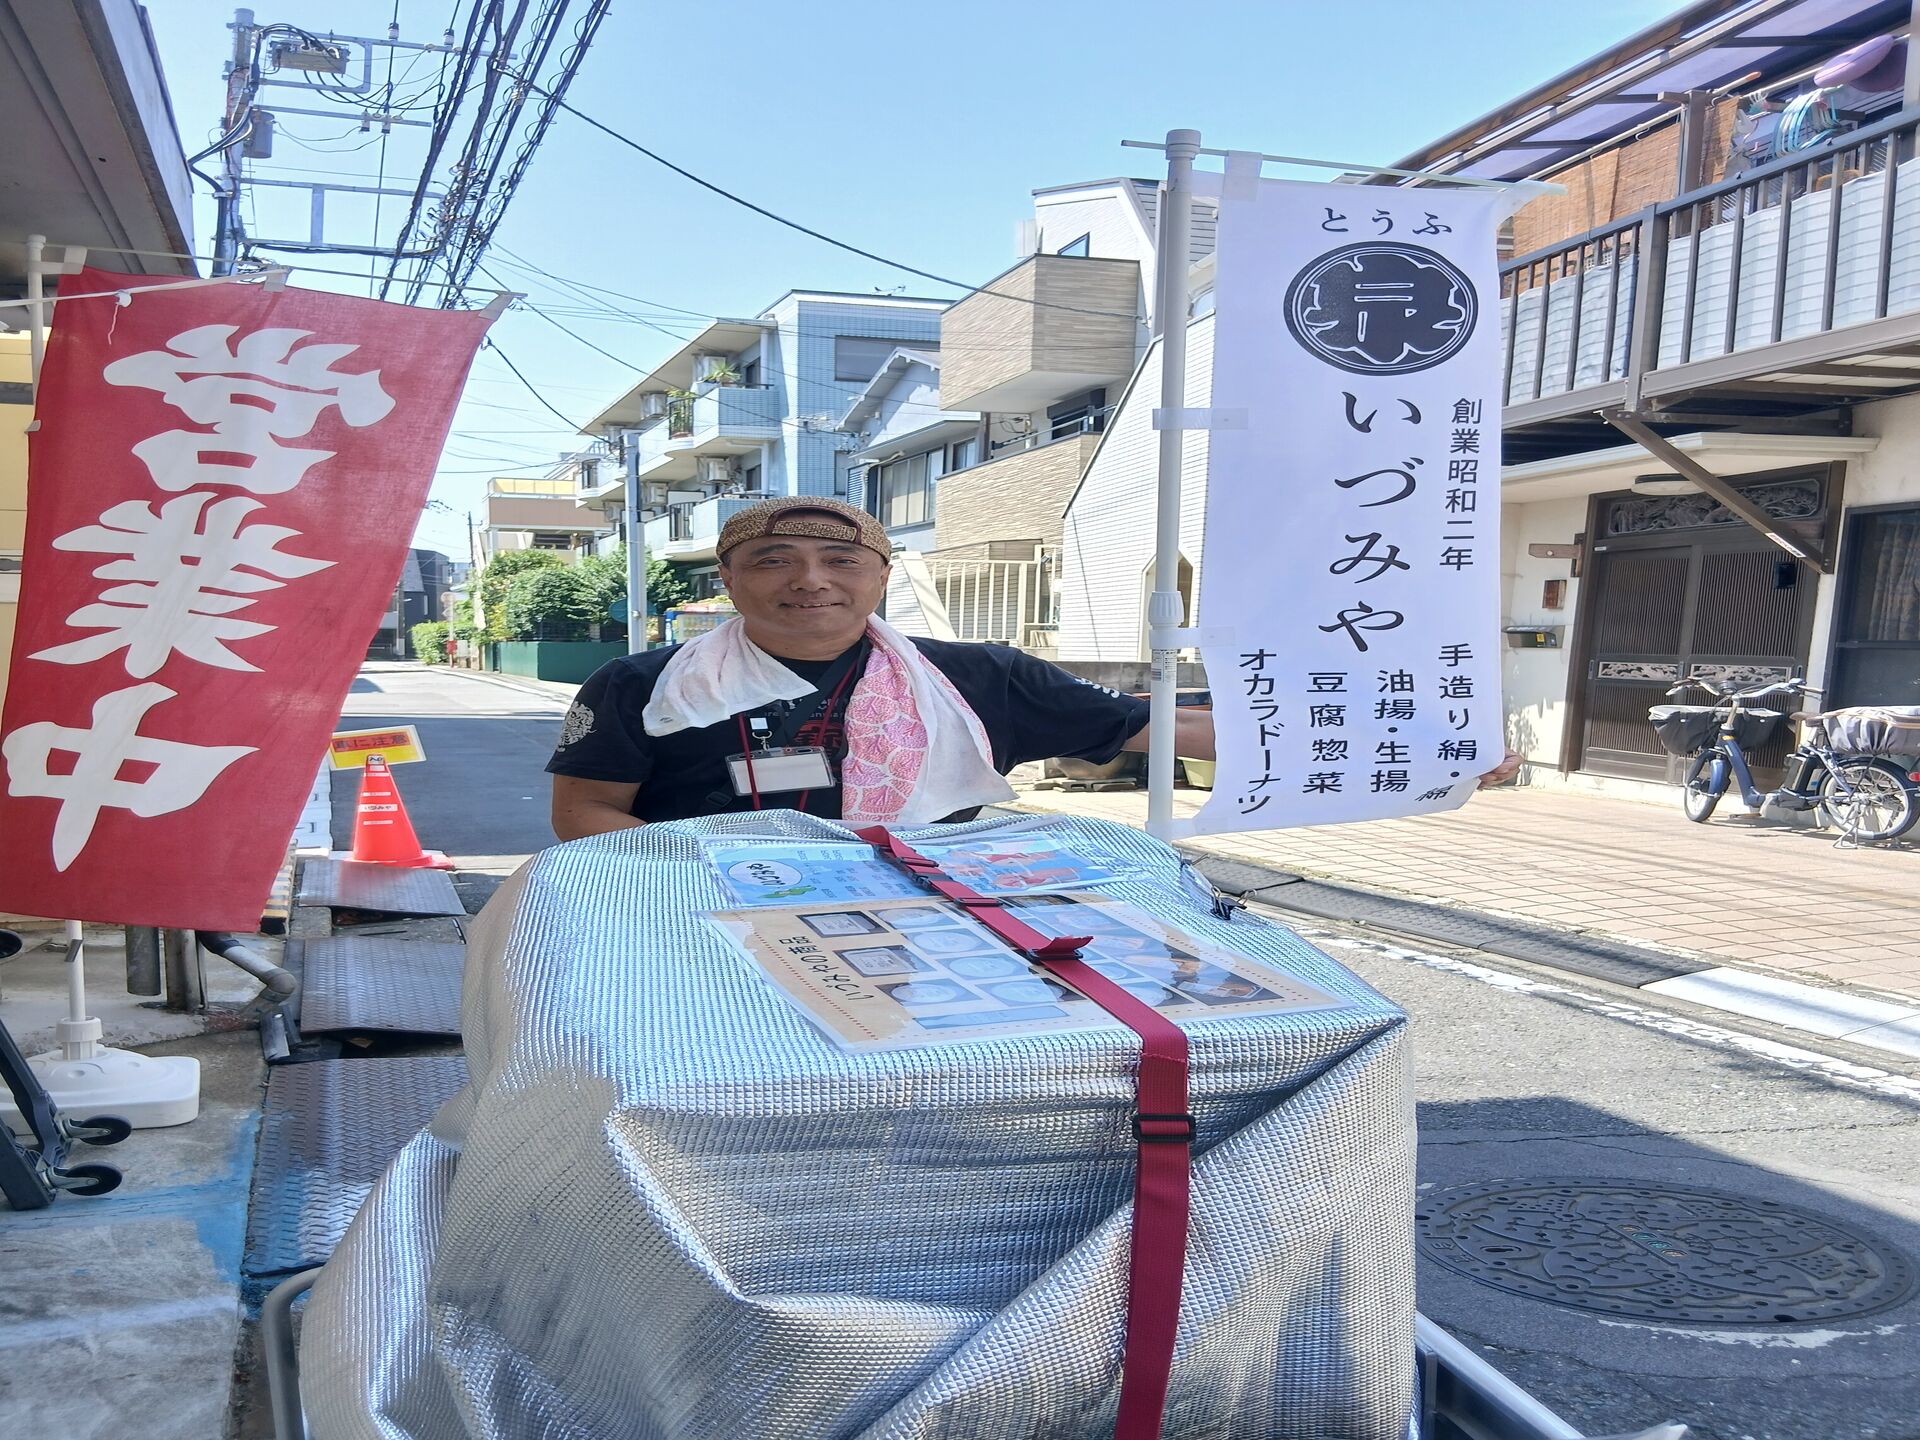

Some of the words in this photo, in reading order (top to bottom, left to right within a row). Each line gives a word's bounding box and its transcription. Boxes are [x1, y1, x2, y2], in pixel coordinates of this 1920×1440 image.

[1321, 207, 1453, 236] とうふ
[1318, 391, 1425, 653] いづみや
[1438, 397, 1482, 572] 創業昭和二年
[2, 324, 396, 872] 営業中
[1238, 648, 1286, 815] オカラドーナツ
[1301, 671, 1349, 795] 豆腐惣菜
[1369, 668, 1418, 793] 油揚・生揚
